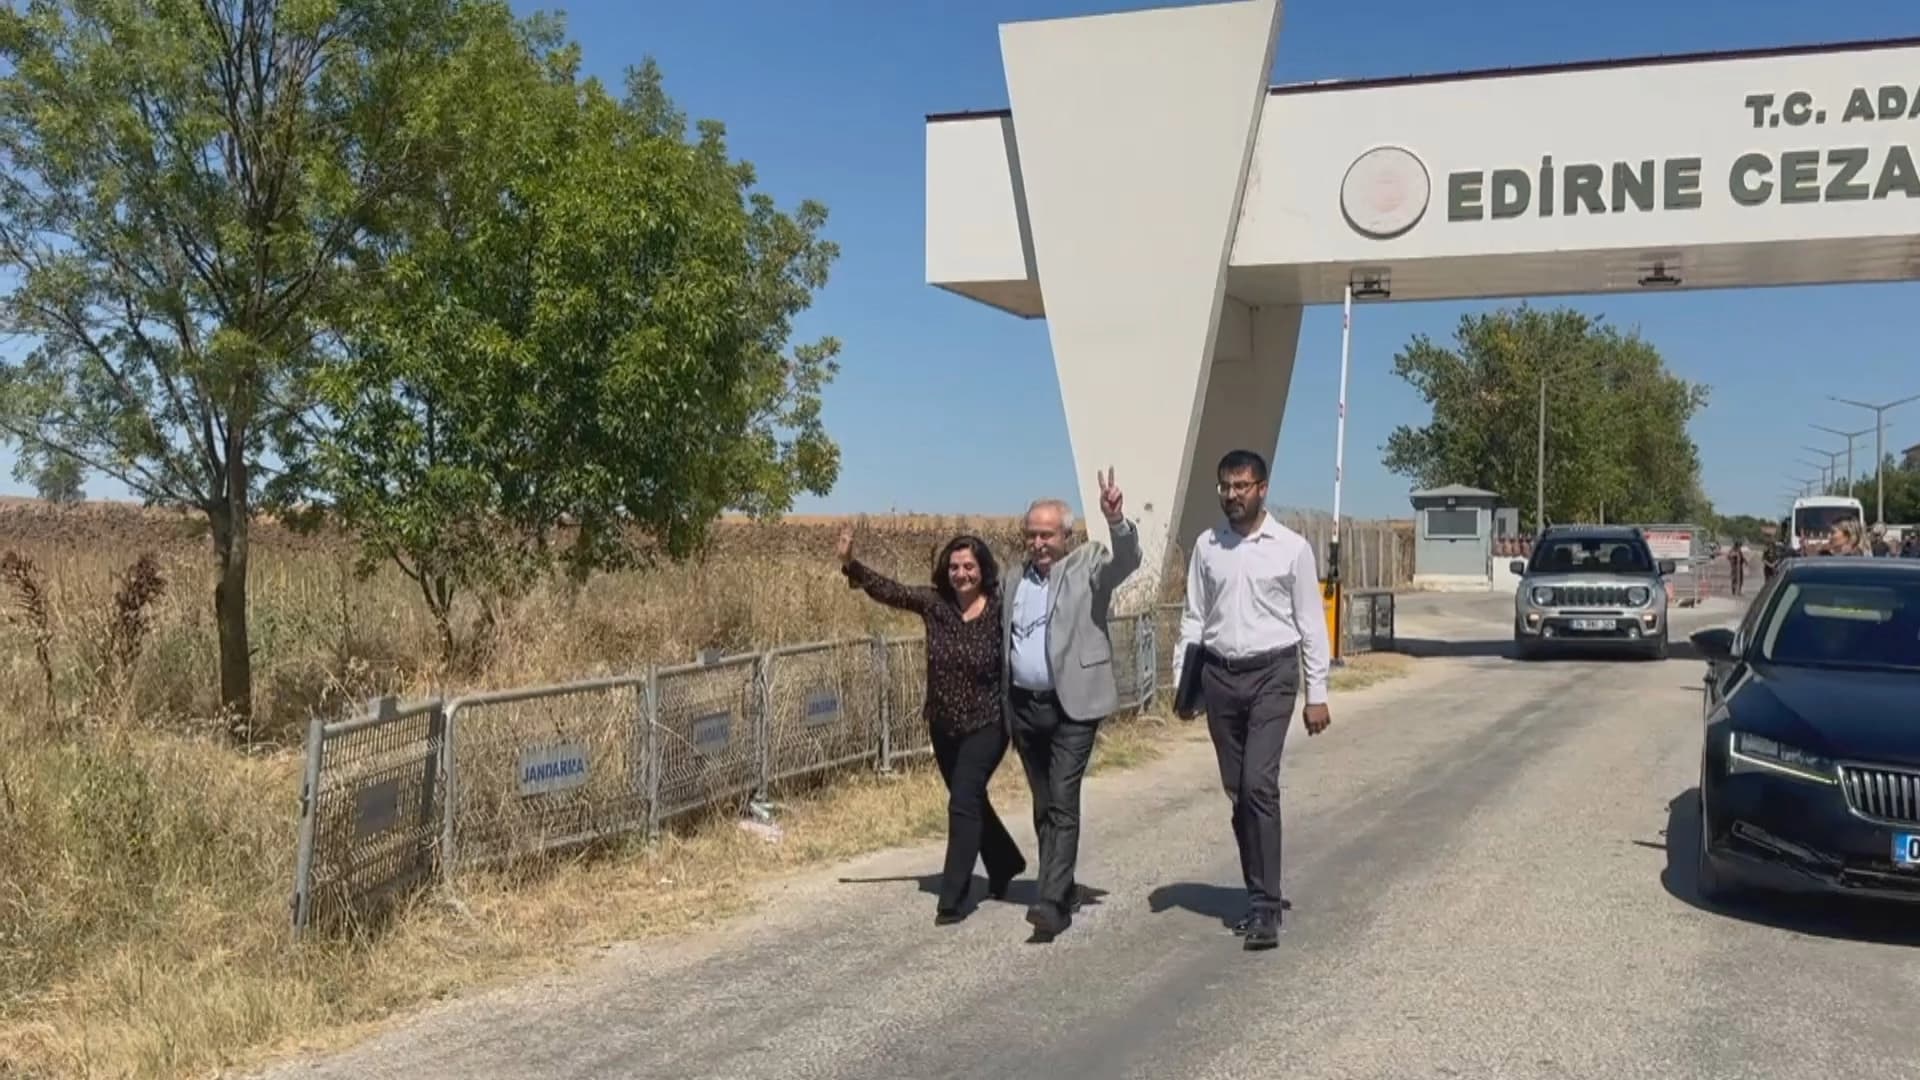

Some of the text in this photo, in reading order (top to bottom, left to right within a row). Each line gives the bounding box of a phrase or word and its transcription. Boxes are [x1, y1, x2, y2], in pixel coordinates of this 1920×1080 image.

[1745, 91, 1826, 128] T.C.
[1447, 146, 1920, 222] EDİRNE CEZA
[523, 758, 584, 784] JANDARMA
